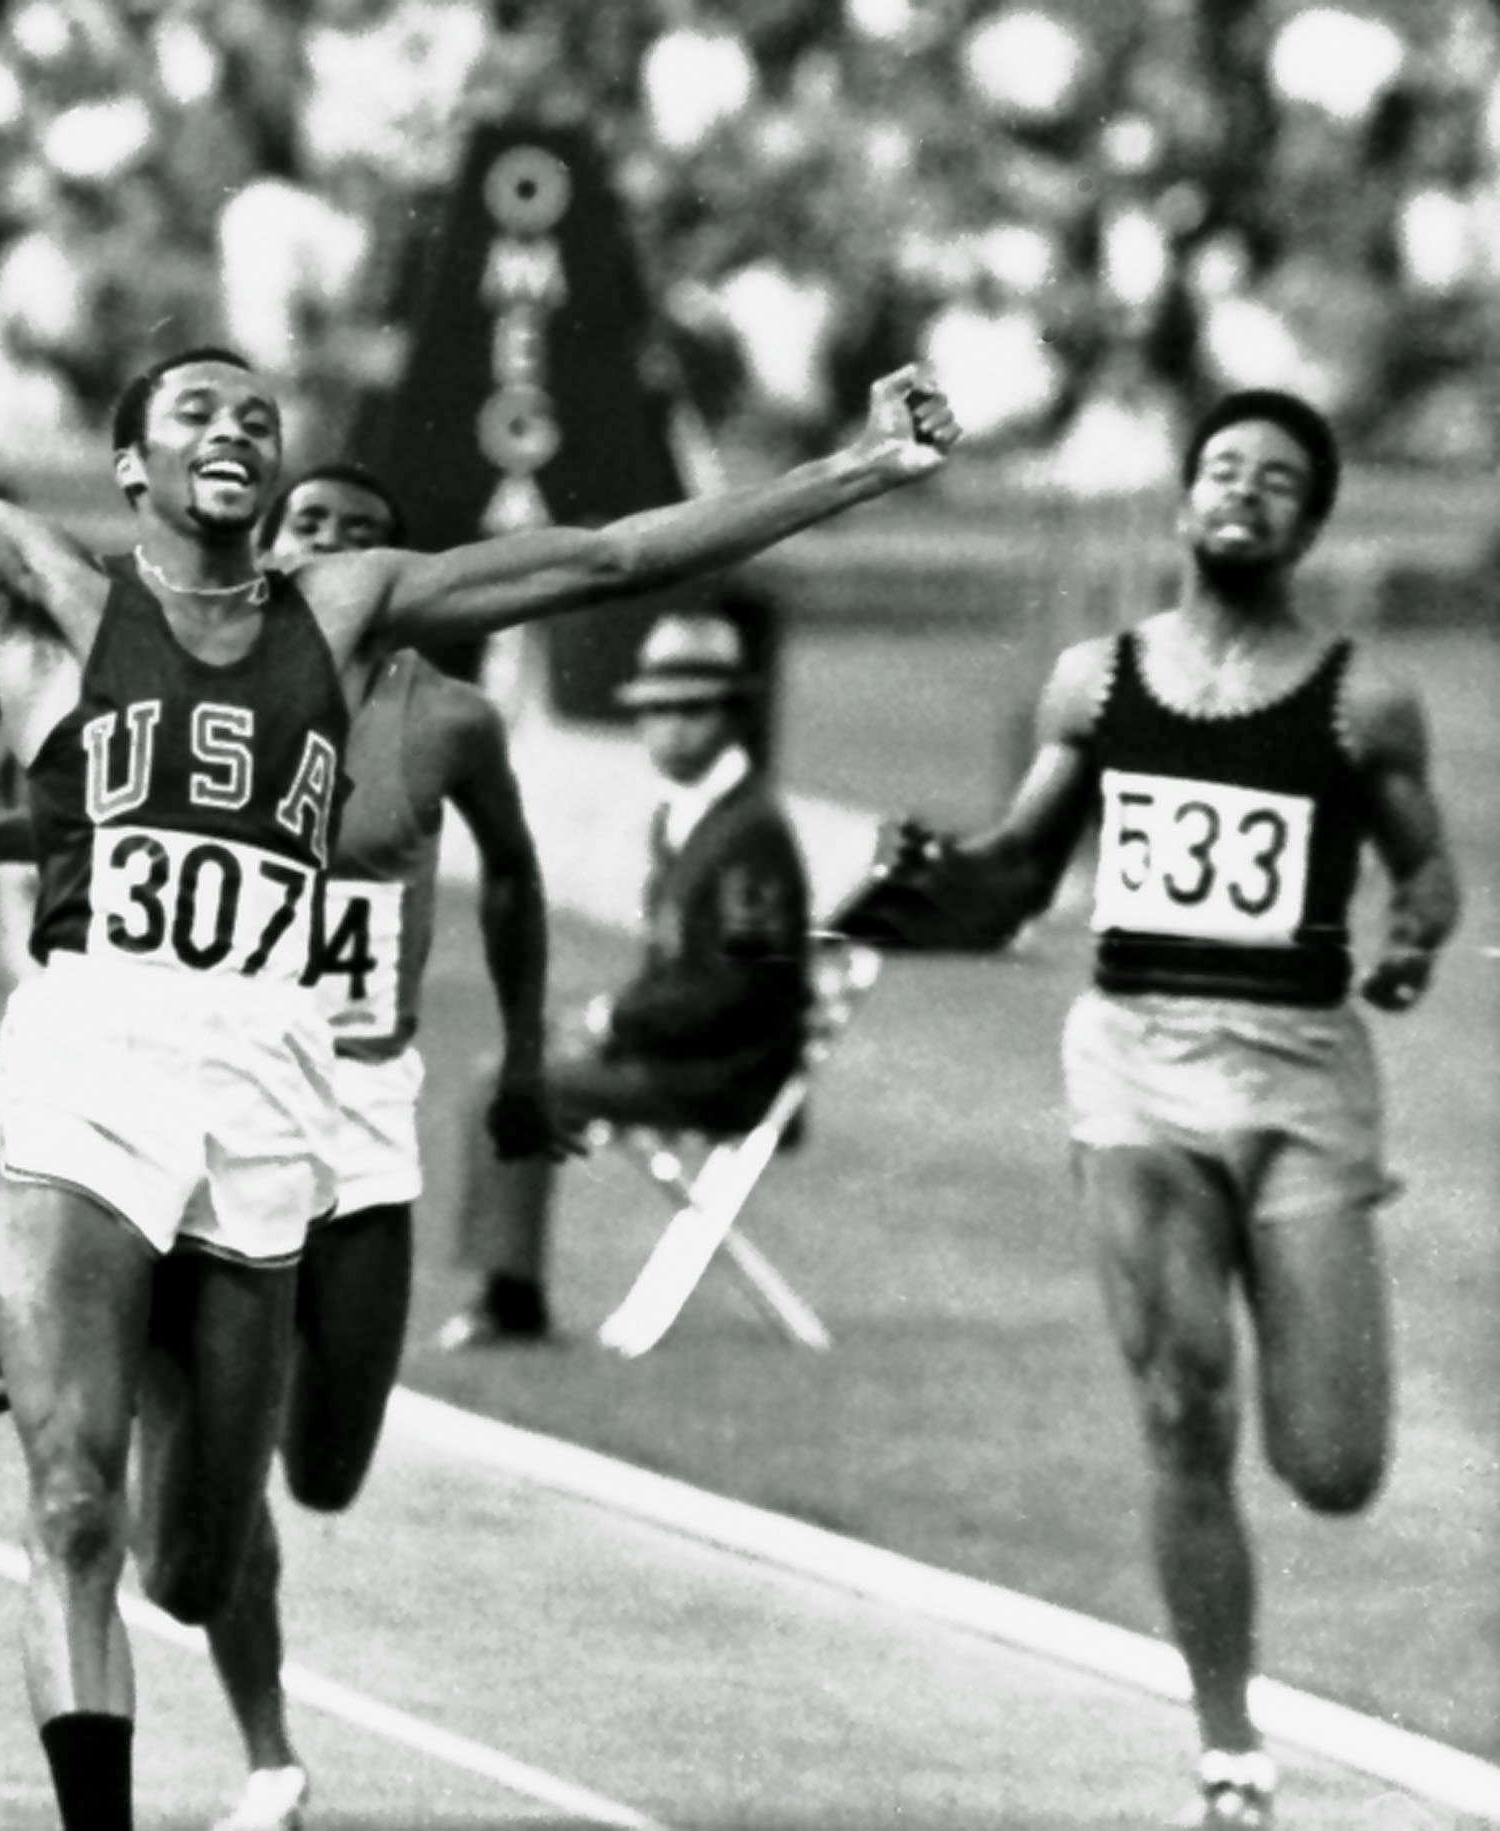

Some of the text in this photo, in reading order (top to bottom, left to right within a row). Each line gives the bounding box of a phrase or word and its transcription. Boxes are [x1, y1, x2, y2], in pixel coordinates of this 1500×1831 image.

[83, 700, 337, 869] USA
[106, 834, 307, 978] 307
[1117, 791, 1289, 917] 533
[318, 896, 378, 1001] 4
